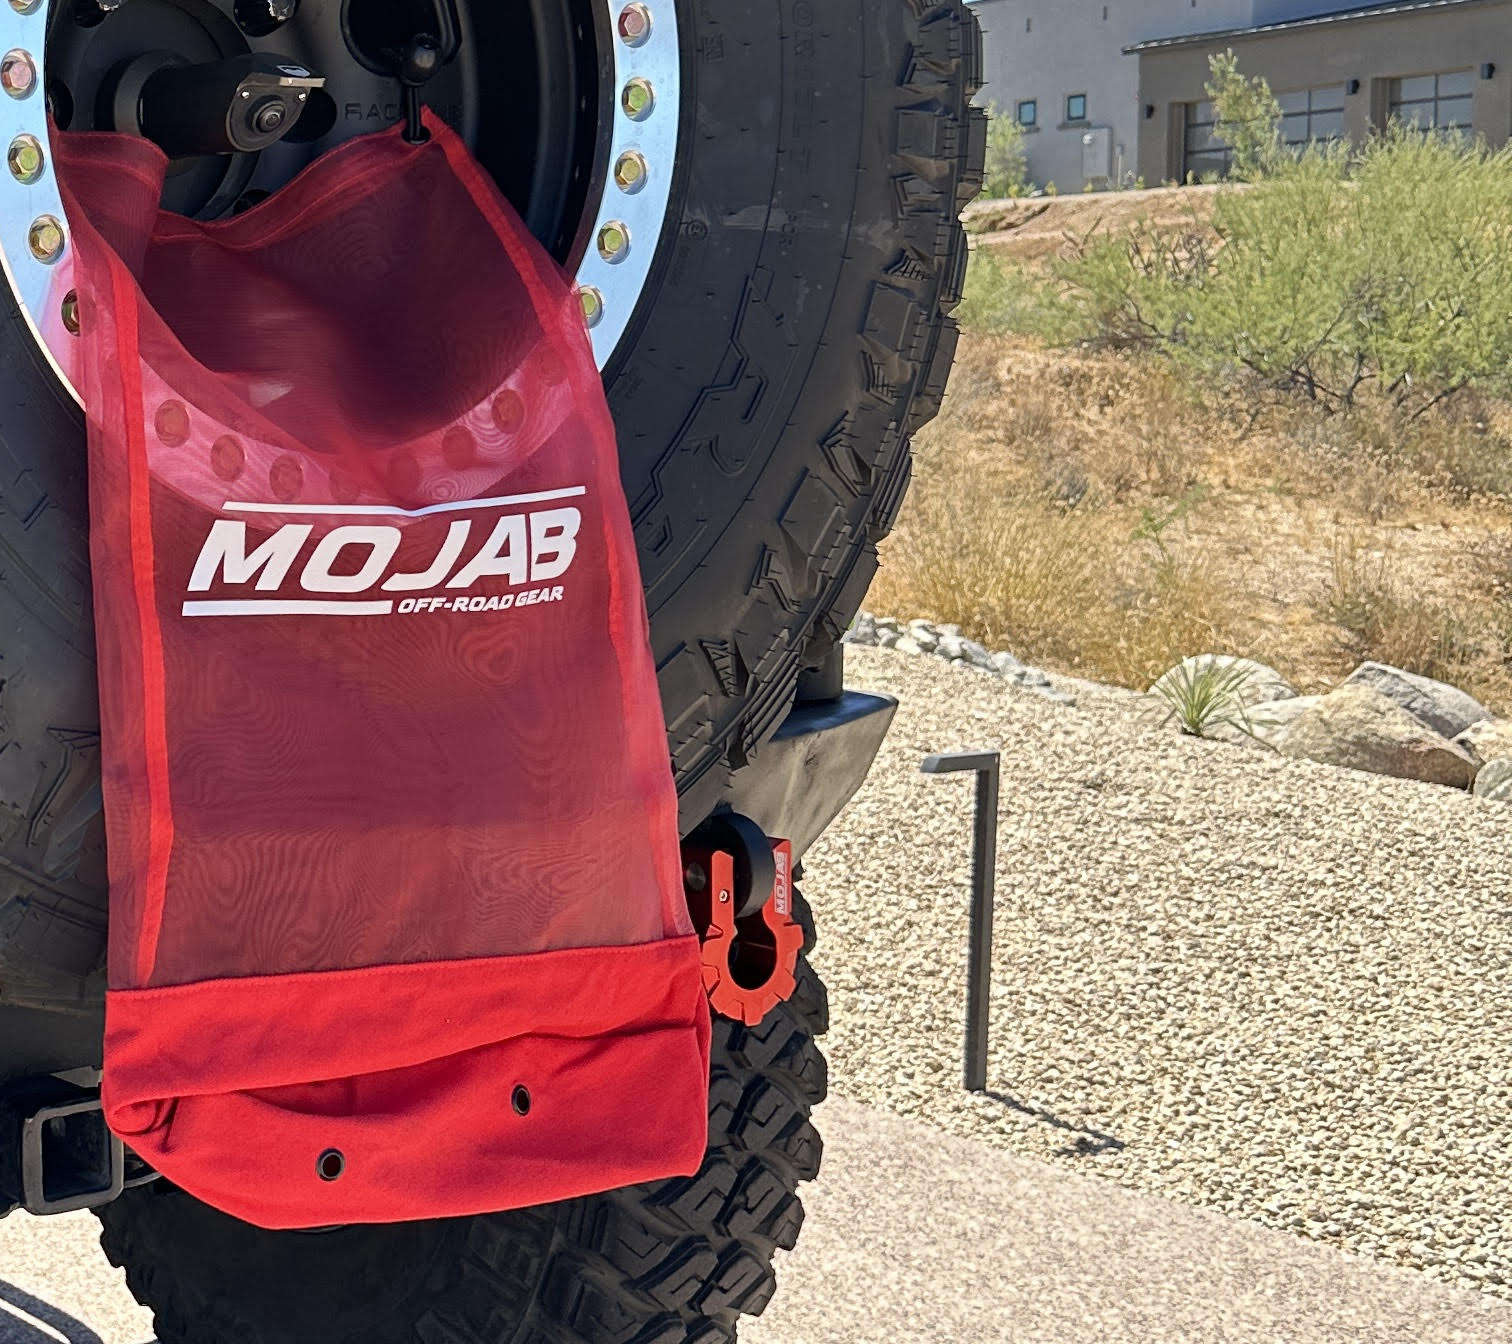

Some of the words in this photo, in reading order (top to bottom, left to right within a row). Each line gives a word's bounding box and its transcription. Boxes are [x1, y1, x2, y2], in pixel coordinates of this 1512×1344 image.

[187, 506, 582, 593] MOJAB
[397, 592, 514, 615] OFF-ROAD
[514, 584, 565, 608] GEAR
[775, 851, 785, 914] MOJAB
